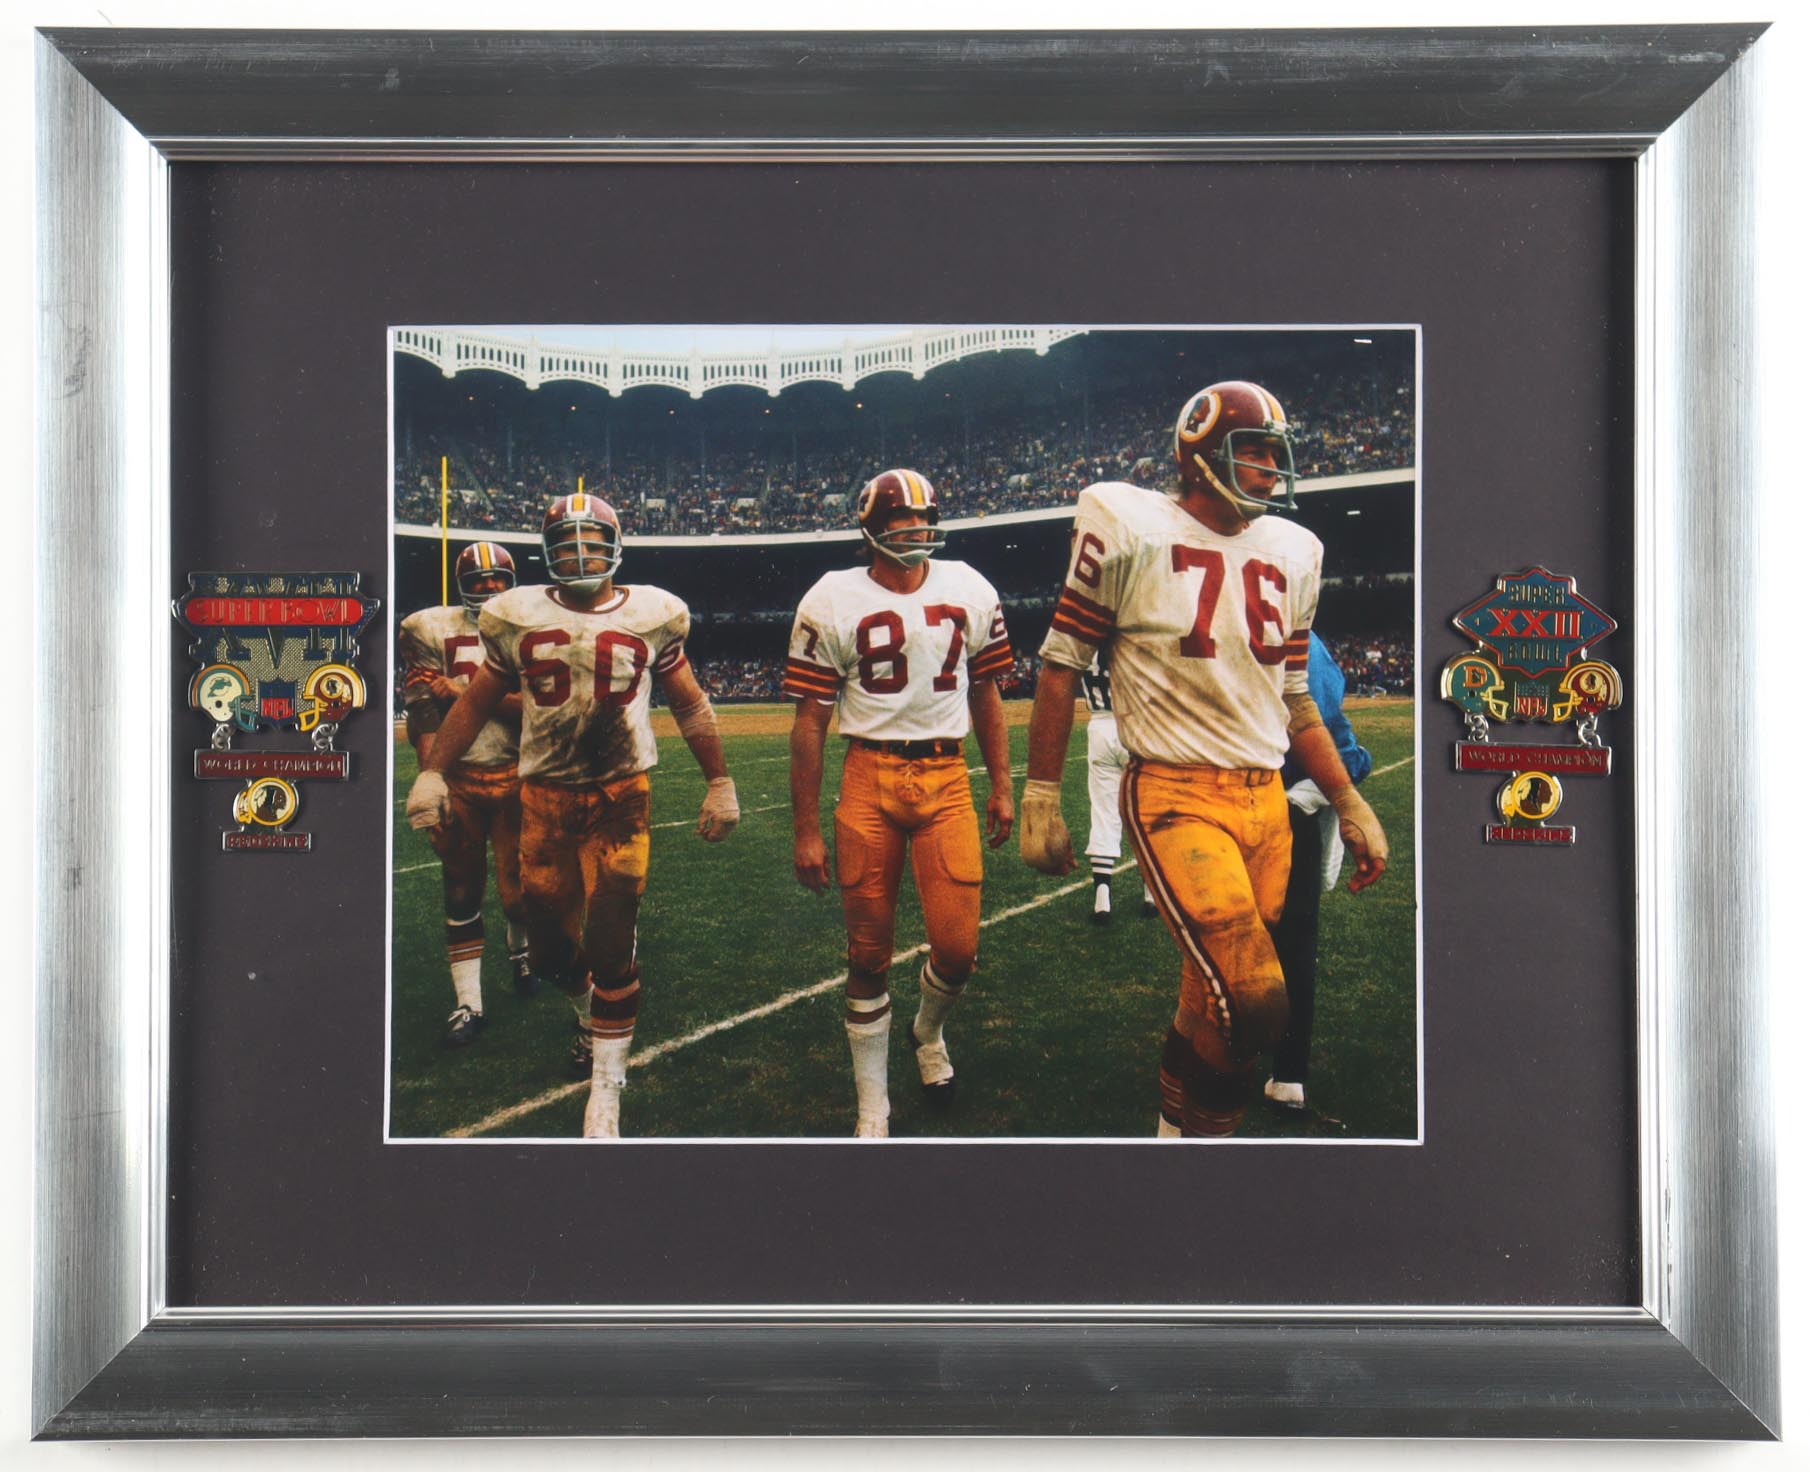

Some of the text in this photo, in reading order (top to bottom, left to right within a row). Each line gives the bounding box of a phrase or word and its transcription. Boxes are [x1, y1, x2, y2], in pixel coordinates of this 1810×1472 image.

[1171, 544, 1287, 666] 76
[1508, 583, 1567, 604] SUPER
[194, 599, 353, 624] SUPER BOWL
[1487, 608, 1584, 638] XXII
[856, 604, 968, 695] 87
[1507, 641, 1563, 663] BOWL
[519, 628, 649, 707] 60
[261, 697, 294, 720] NFL
[1516, 697, 1548, 717] NFL
[203, 758, 342, 772] WORLD CHAMPION
[1468, 751, 1602, 767] WORLD CHAMPION
